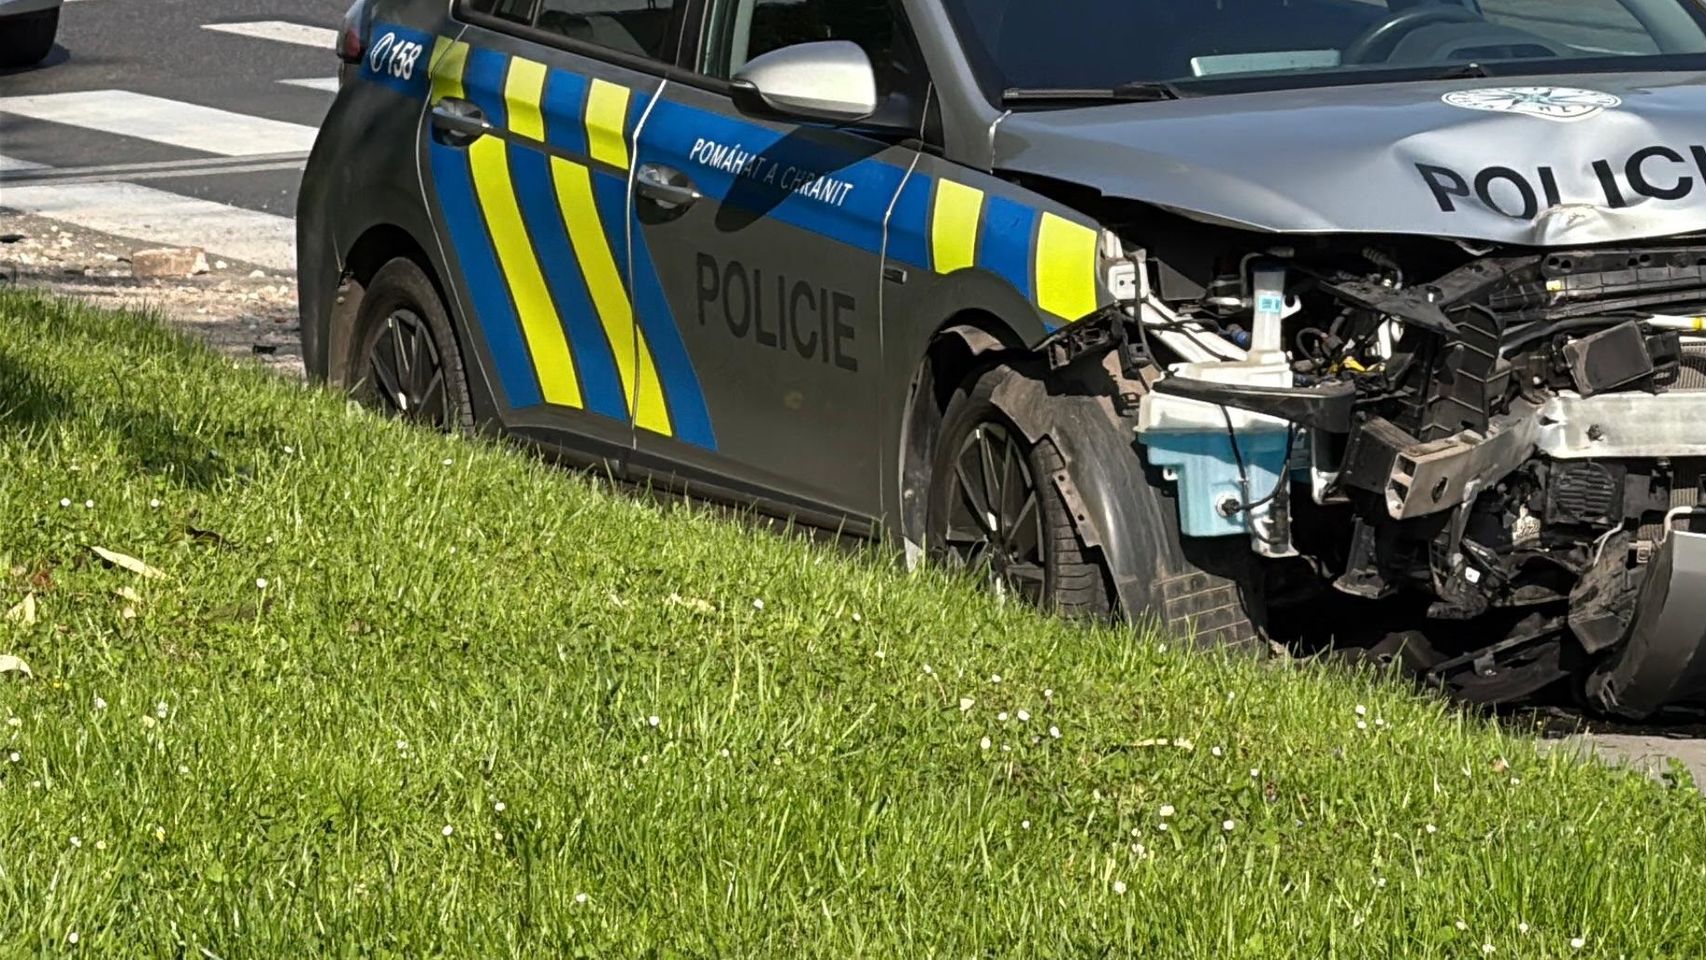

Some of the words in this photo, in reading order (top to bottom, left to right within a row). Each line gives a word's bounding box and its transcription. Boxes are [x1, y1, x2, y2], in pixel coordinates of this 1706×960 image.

[388, 39, 423, 80] 158
[690, 138, 767, 178] POMÁHAT
[763, 162, 776, 185] A
[780, 165, 854, 207] CHRÁNIT
[696, 251, 859, 373] POLICIE
